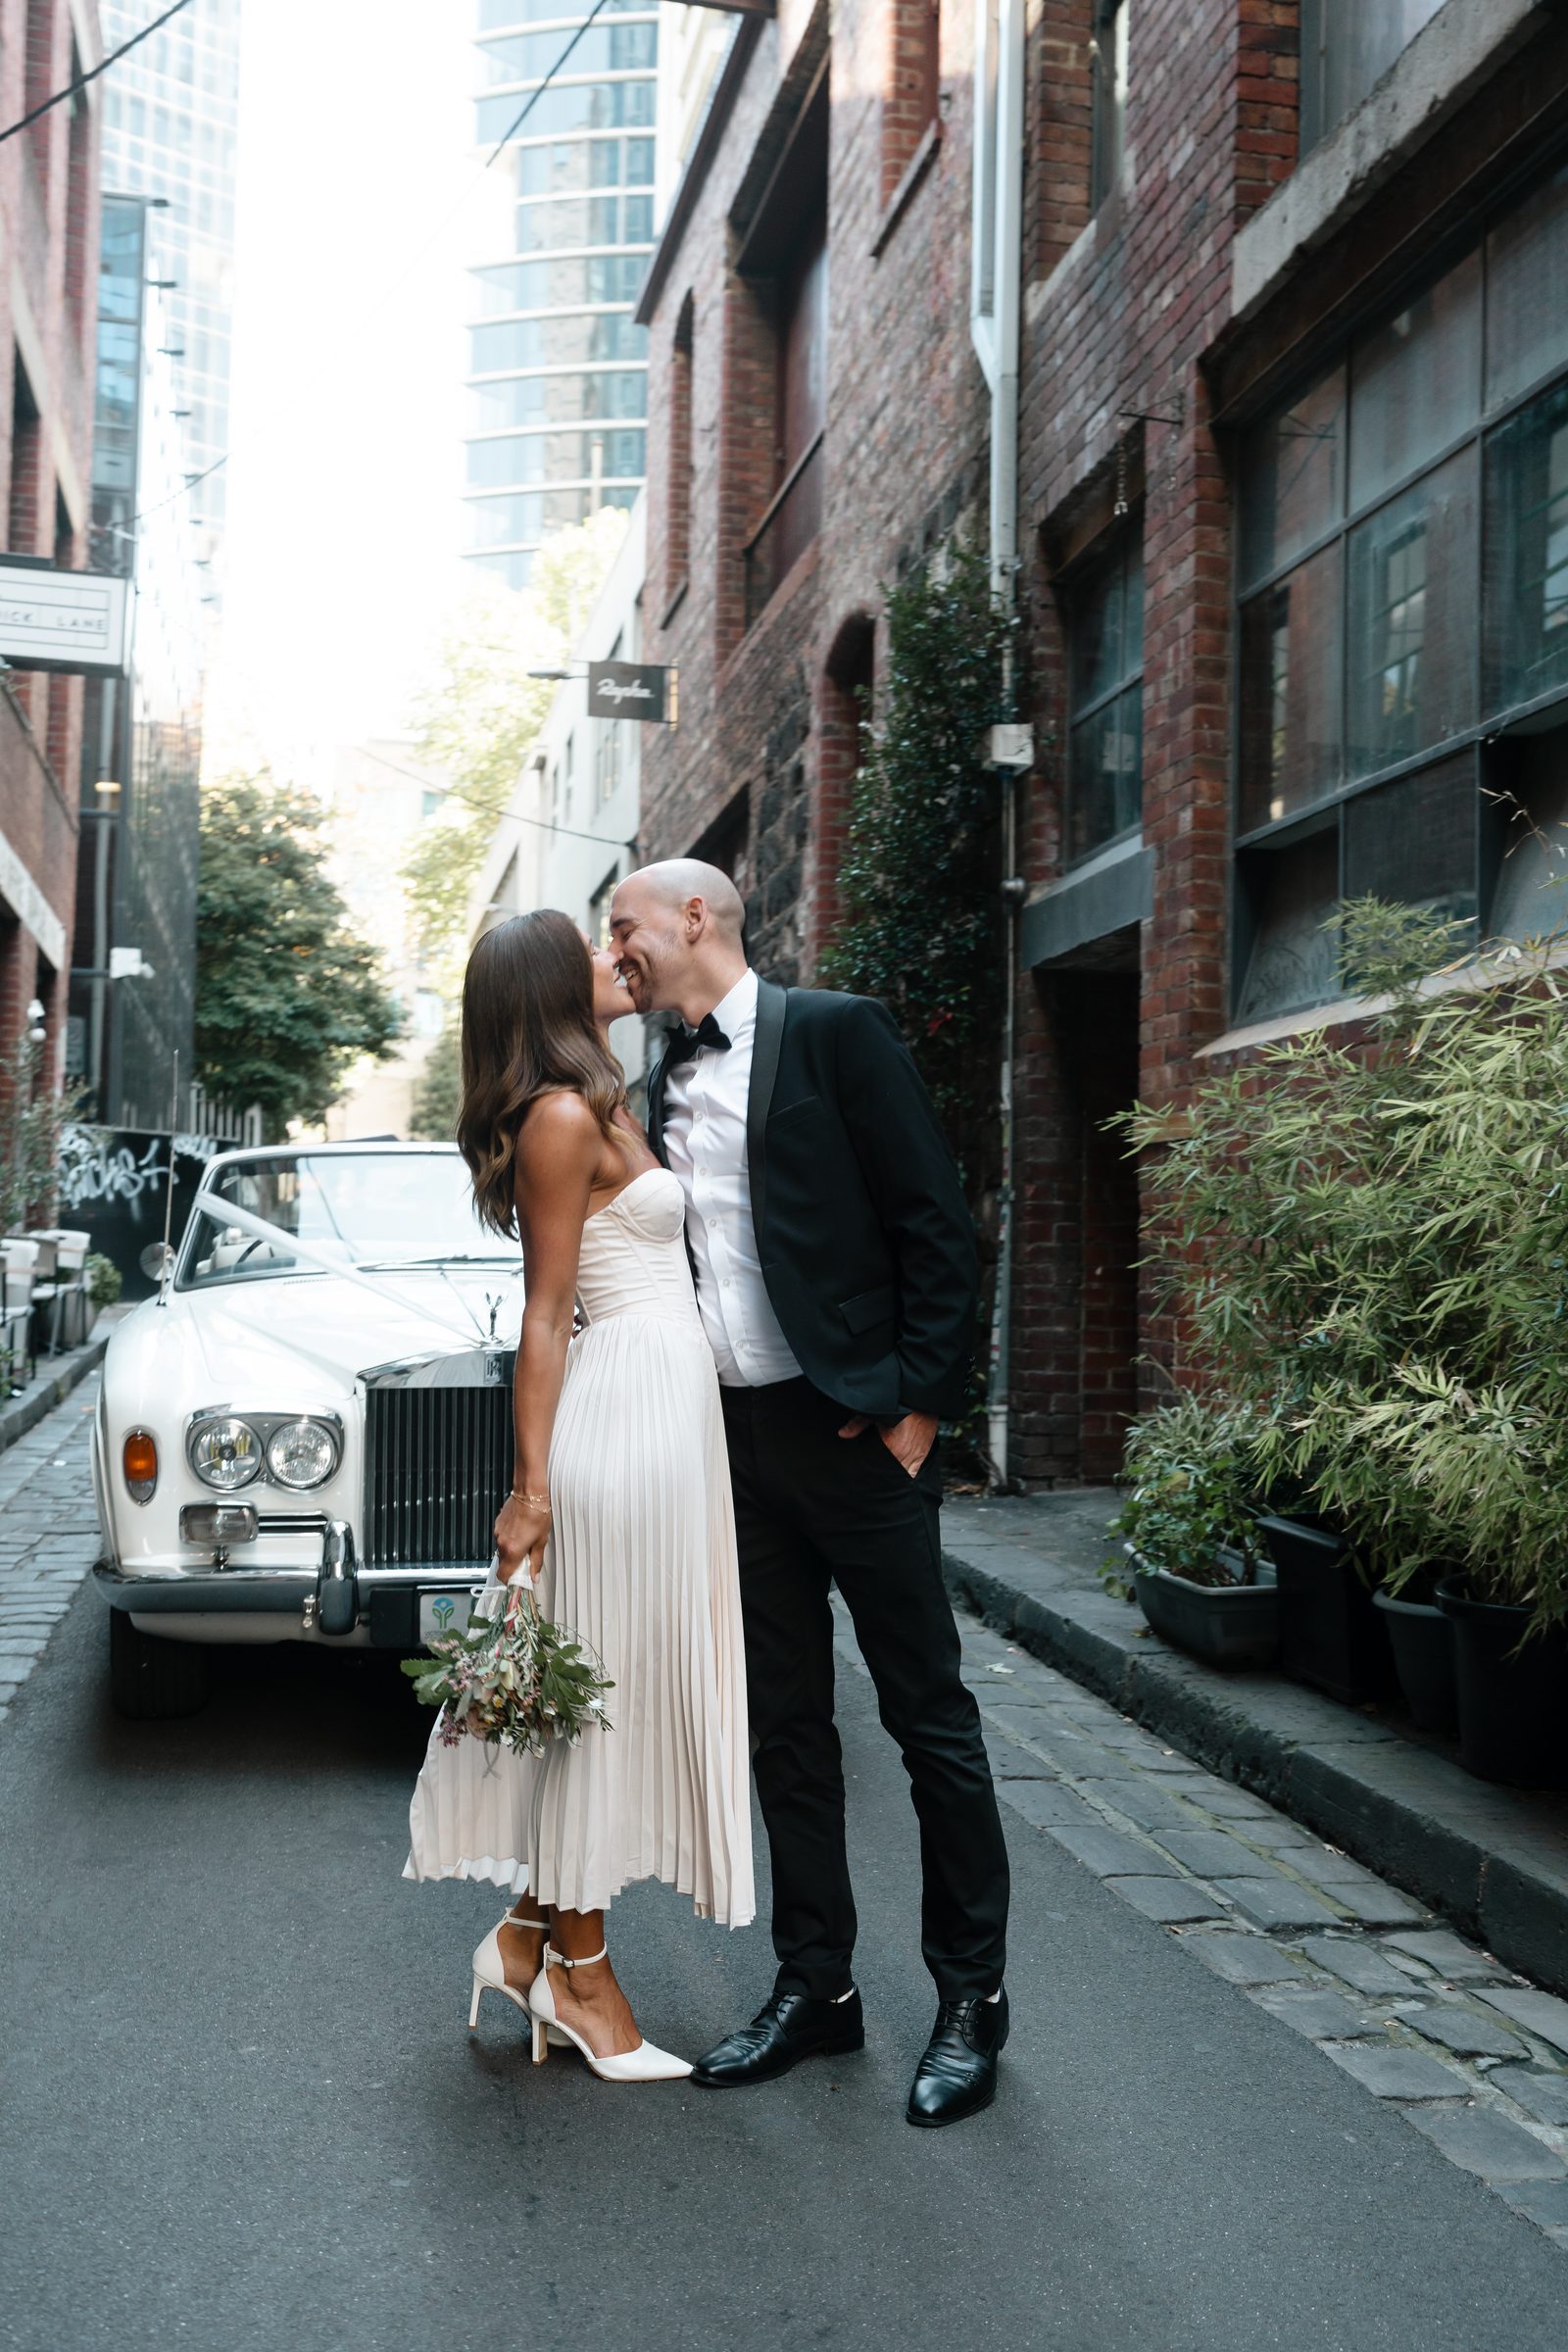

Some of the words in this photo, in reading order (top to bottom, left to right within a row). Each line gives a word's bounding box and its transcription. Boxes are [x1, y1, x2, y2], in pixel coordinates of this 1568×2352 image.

[0, 610, 33, 623] ICK
[57, 615, 103, 630] LANE
[596, 678, 655, 705] Rapha
